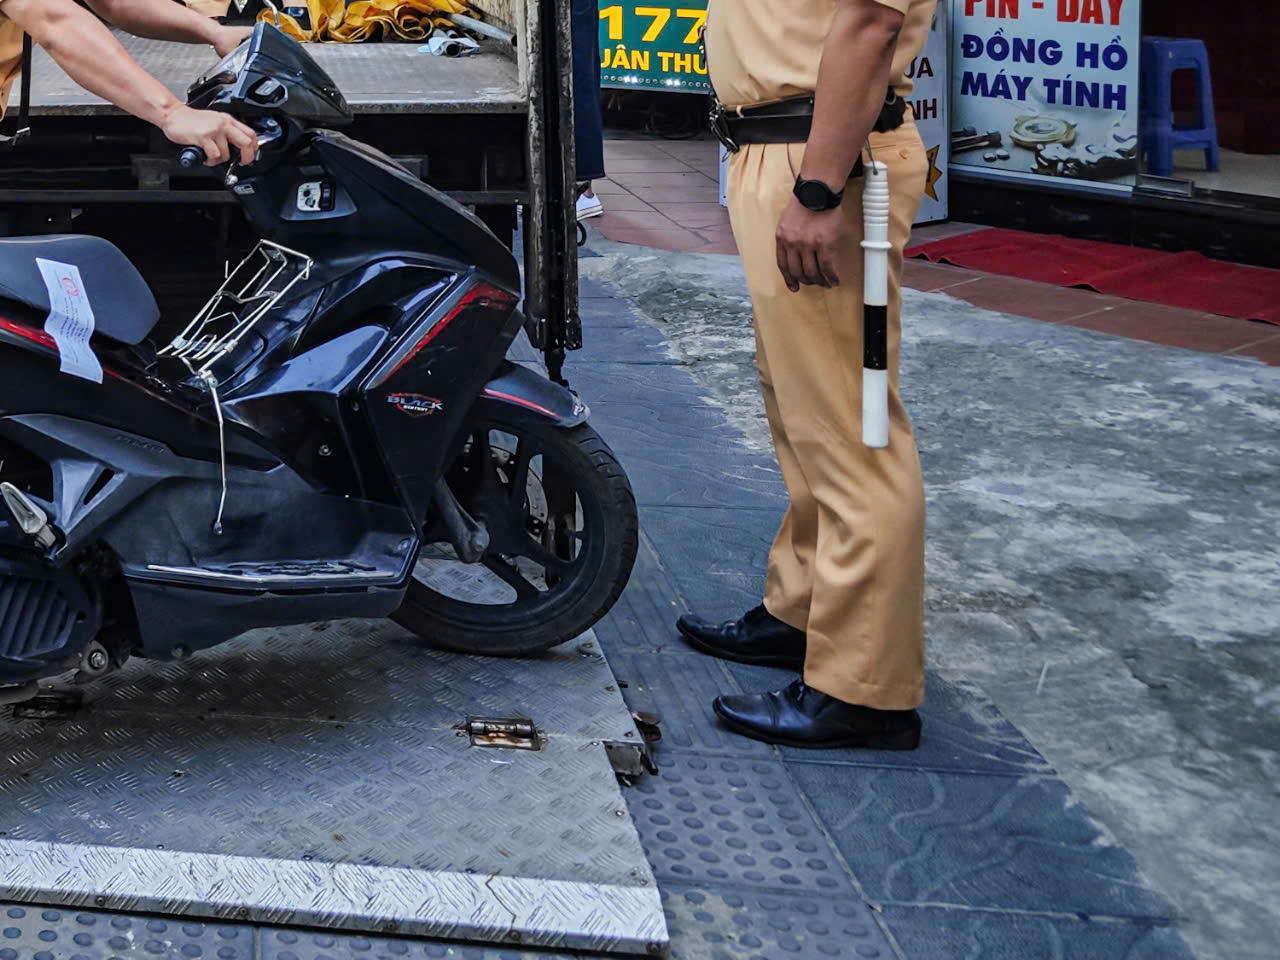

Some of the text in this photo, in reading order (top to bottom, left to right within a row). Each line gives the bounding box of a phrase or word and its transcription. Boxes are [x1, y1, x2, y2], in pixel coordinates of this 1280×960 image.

[599, 5, 709, 44] 177
[961, 27, 1129, 71] ĐỒNG HỒ
[960, 68, 1128, 111] MÁY TÍNH
[387, 395, 443, 410] BLACK
